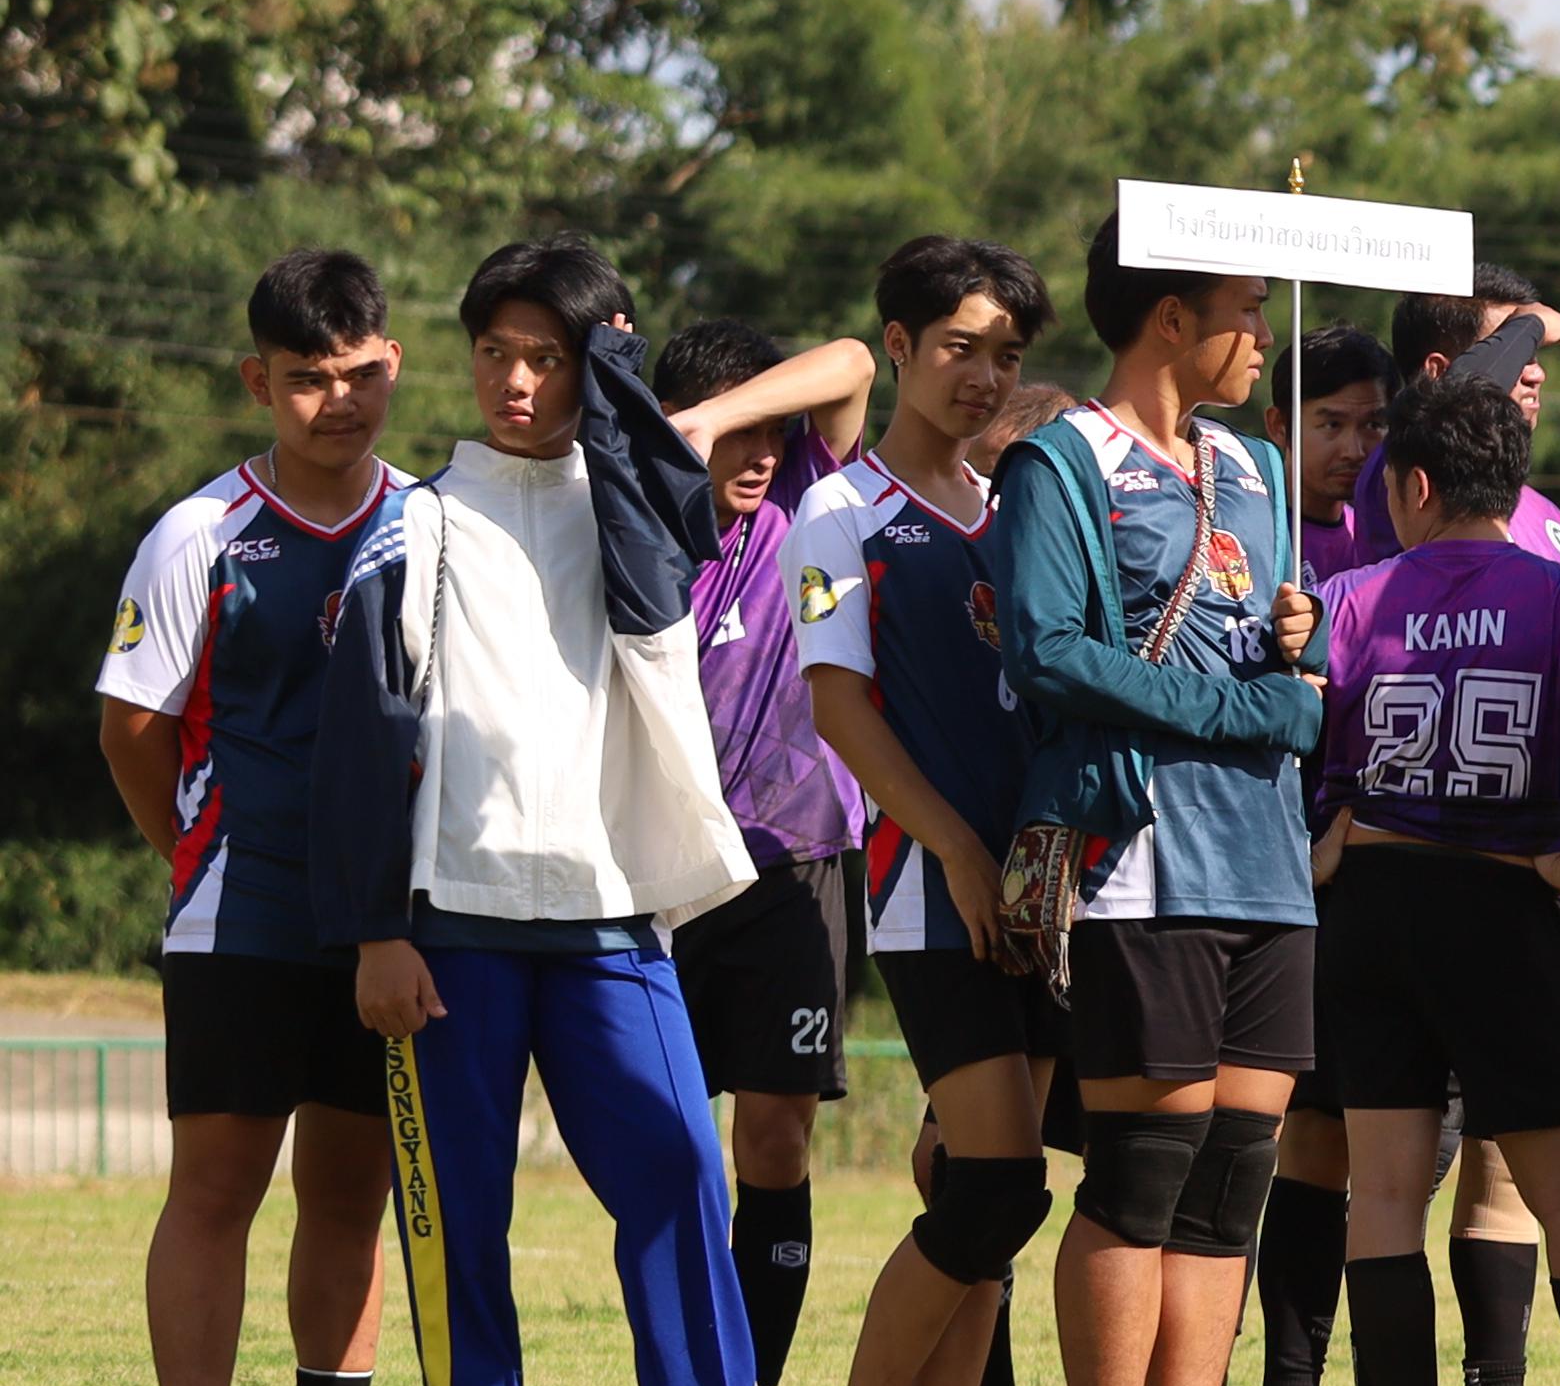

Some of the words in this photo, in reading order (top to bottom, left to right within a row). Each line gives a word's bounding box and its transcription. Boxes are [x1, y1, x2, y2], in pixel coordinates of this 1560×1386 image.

[1166, 203, 1433, 263] โรงเรียนท่าสองยางวิทยาคม
[1224, 615, 1267, 664] 18
[1404, 608, 1506, 652] KANN
[1356, 667, 1543, 800] 25
[790, 1006, 829, 1054] 22
